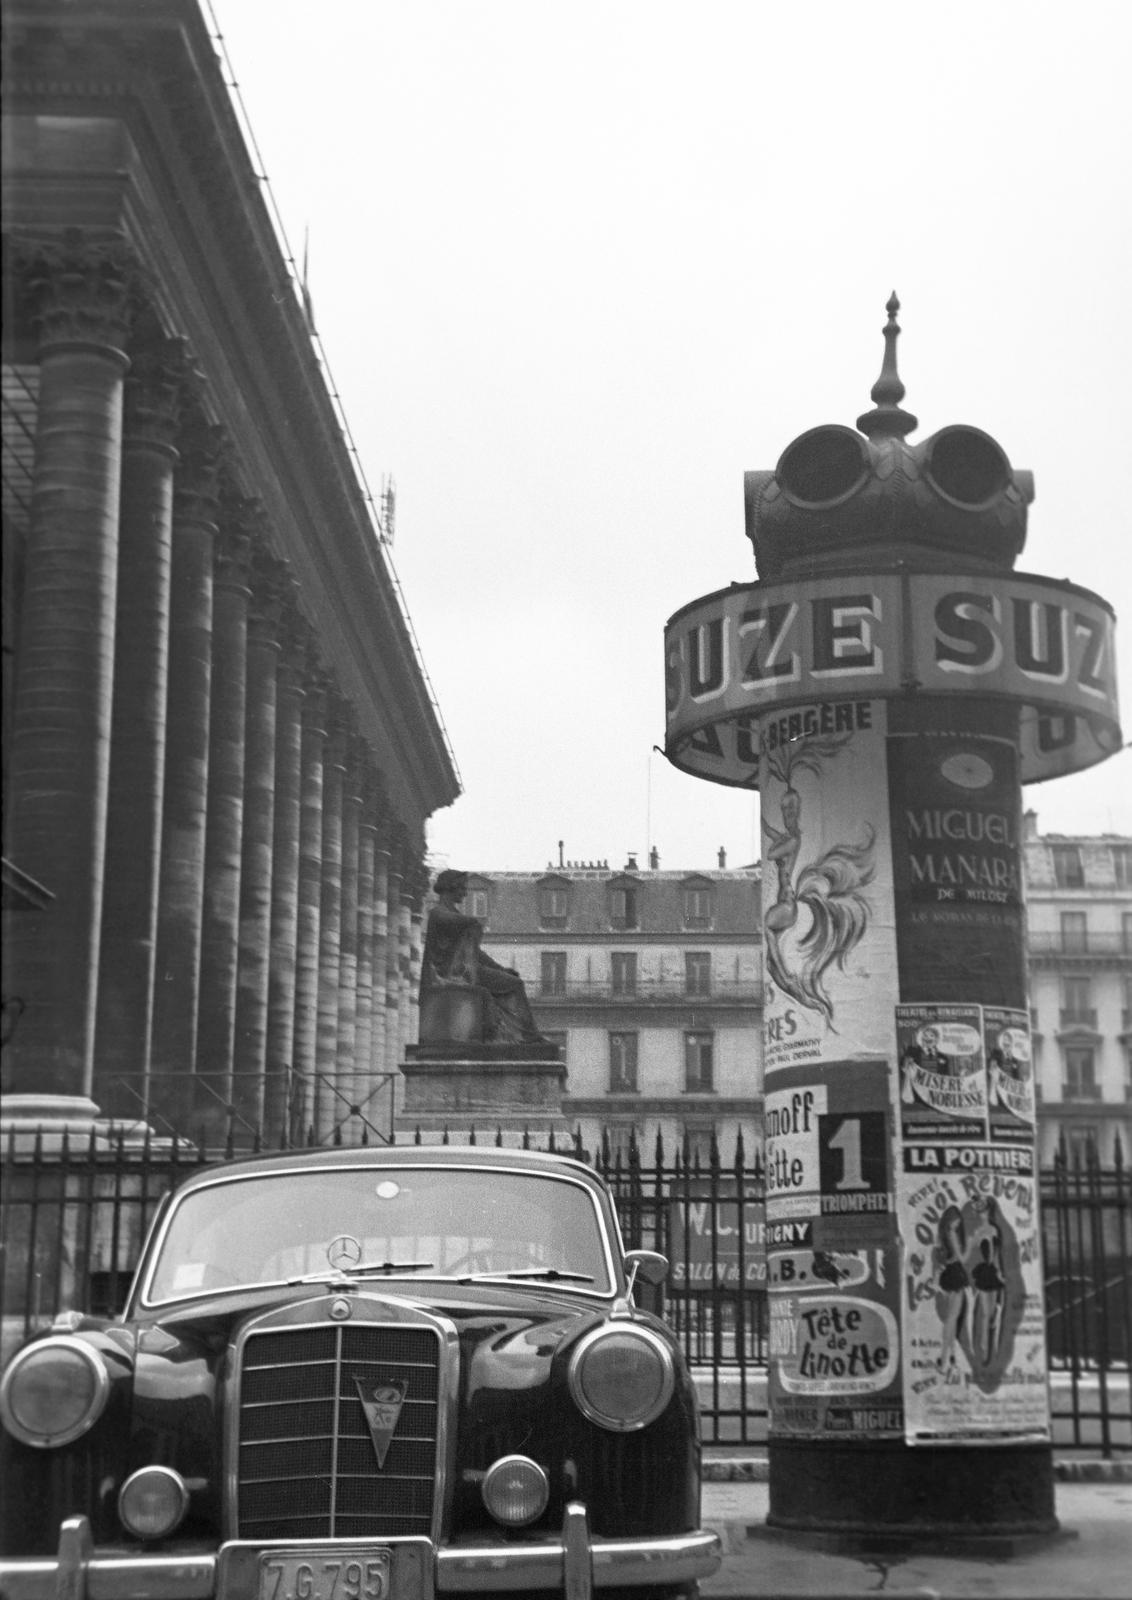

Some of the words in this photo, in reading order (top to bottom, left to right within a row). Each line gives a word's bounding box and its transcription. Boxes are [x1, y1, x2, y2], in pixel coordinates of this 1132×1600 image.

[910, 1148, 939, 1167] LA
[801, 1307, 862, 1341] Tête
[826, 1333, 848, 1351] de
